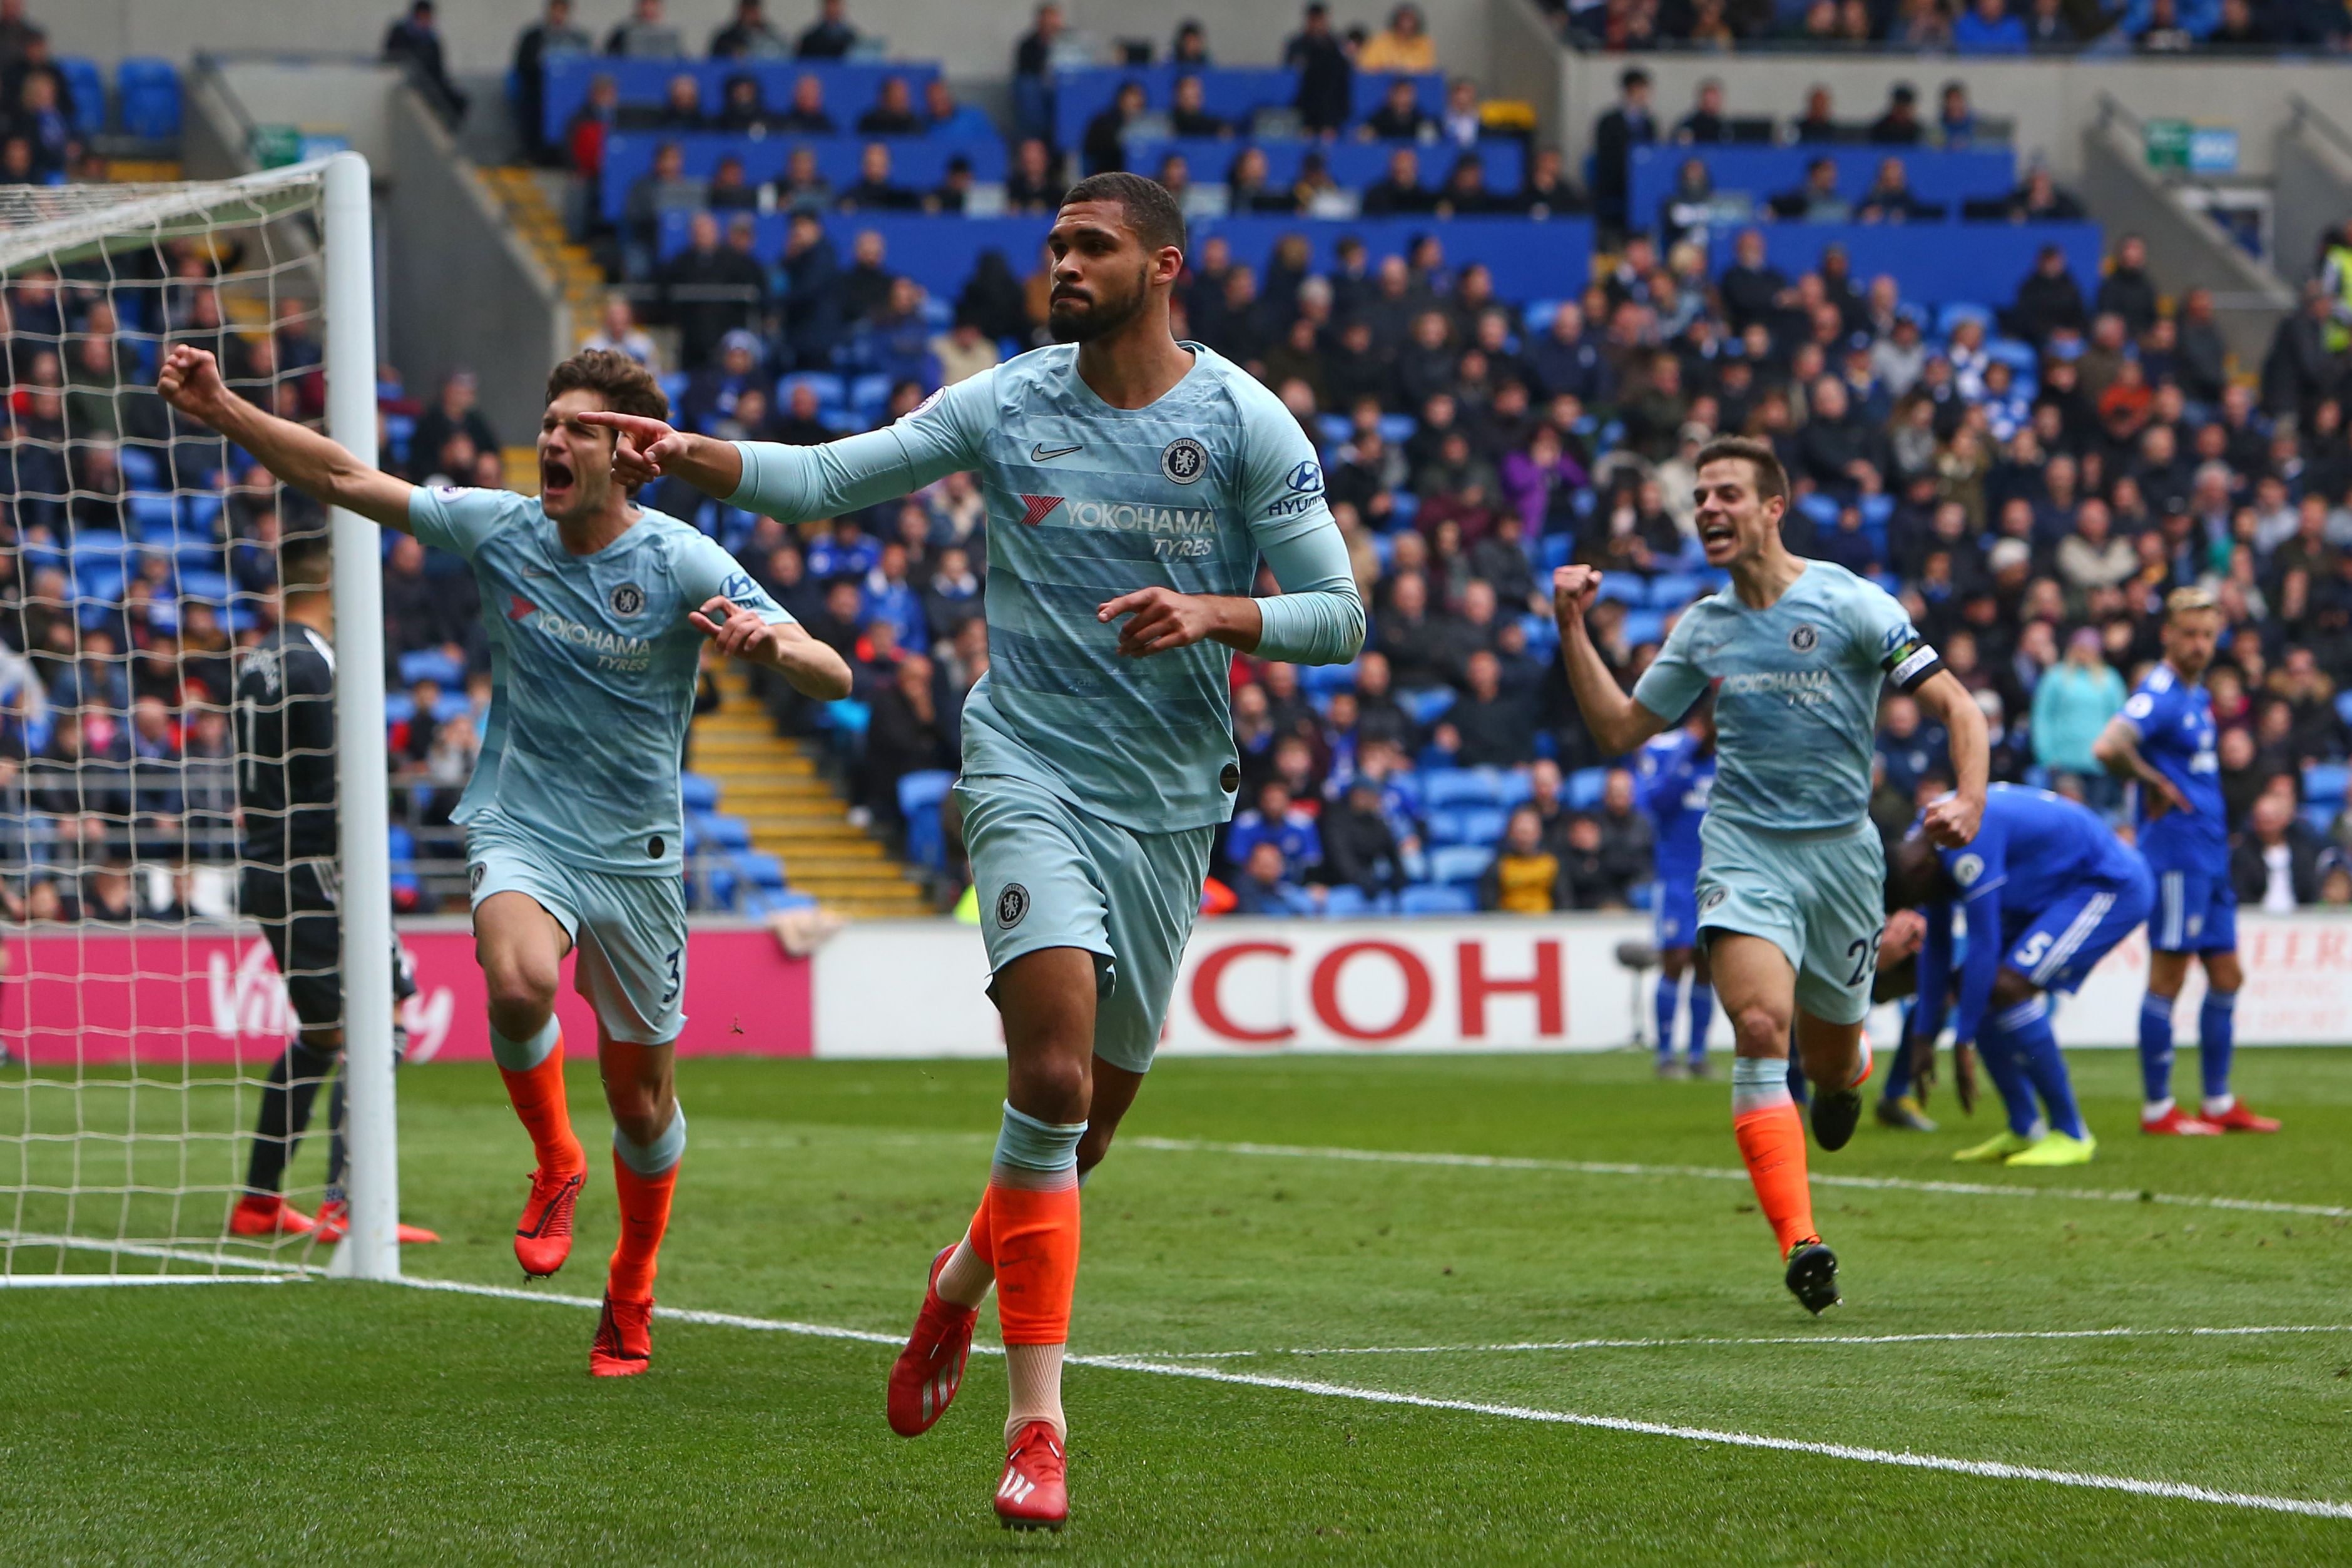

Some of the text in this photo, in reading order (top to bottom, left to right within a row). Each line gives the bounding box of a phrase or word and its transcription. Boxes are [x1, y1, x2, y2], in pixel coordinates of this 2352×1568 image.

[1064, 500, 1216, 534] YOKOHAMA
[1154, 537, 1213, 556] TYRES
[535, 609, 651, 655] YOKOHAMA
[598, 655, 649, 671] TYRES
[2013, 930, 2053, 967] 5
[662, 949, 680, 1003] 3
[1165, 940, 1564, 1042] COH
